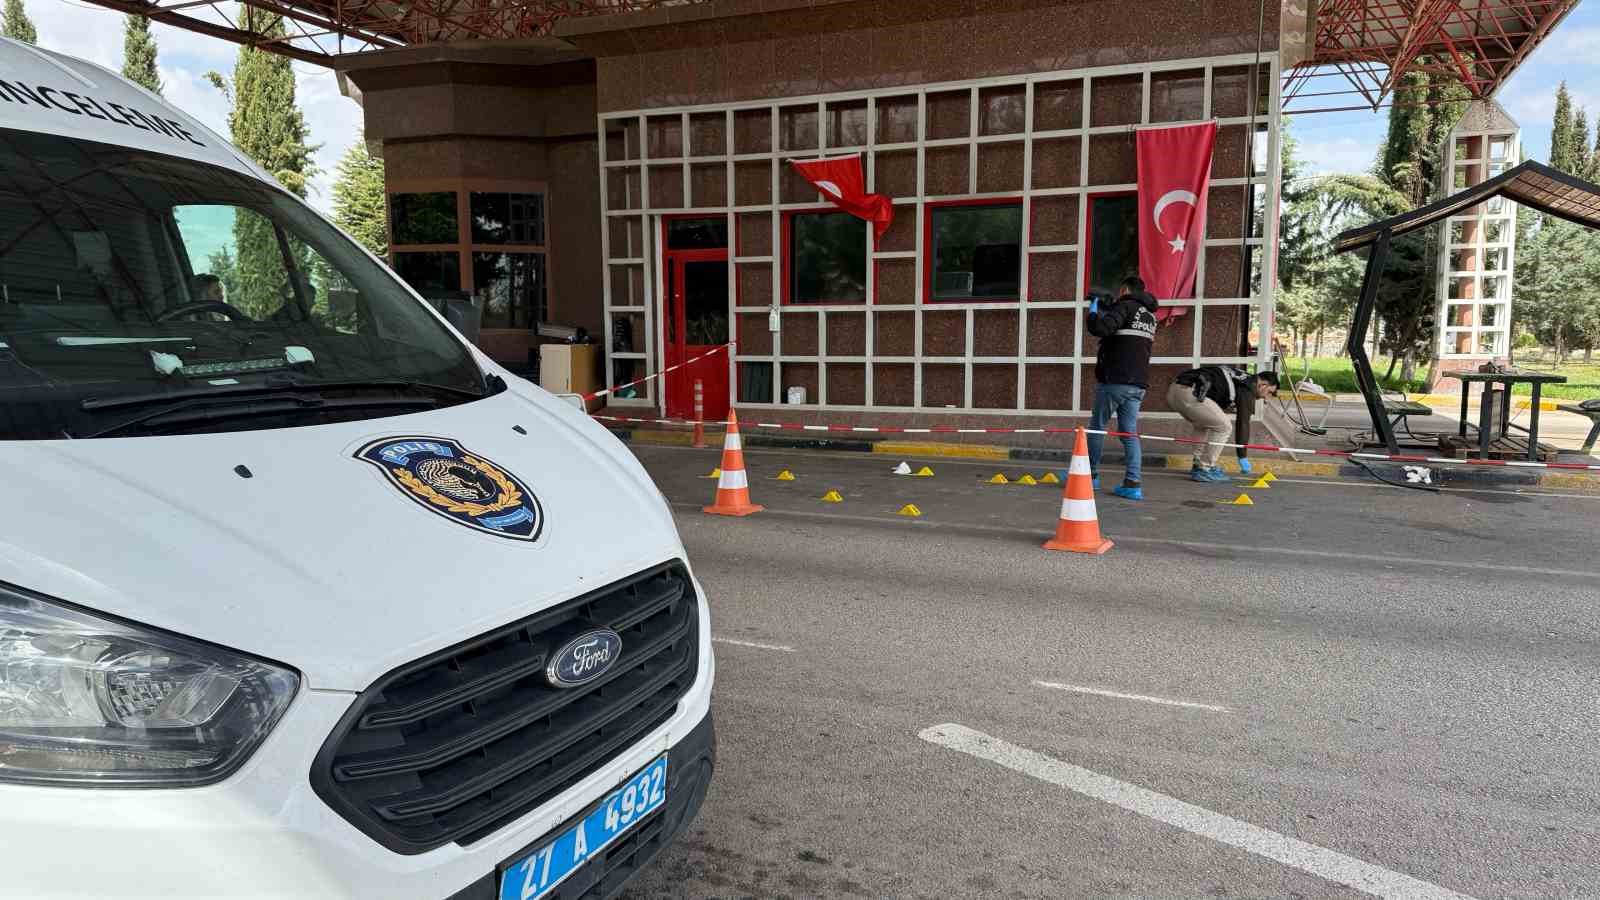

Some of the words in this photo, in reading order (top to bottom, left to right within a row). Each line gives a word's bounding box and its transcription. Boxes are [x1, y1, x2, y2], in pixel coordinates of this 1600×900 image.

[573, 640, 610, 675] Ford
[520, 840, 557, 898] 27
[573, 819, 589, 863] A
[604, 766, 663, 832] 4932
